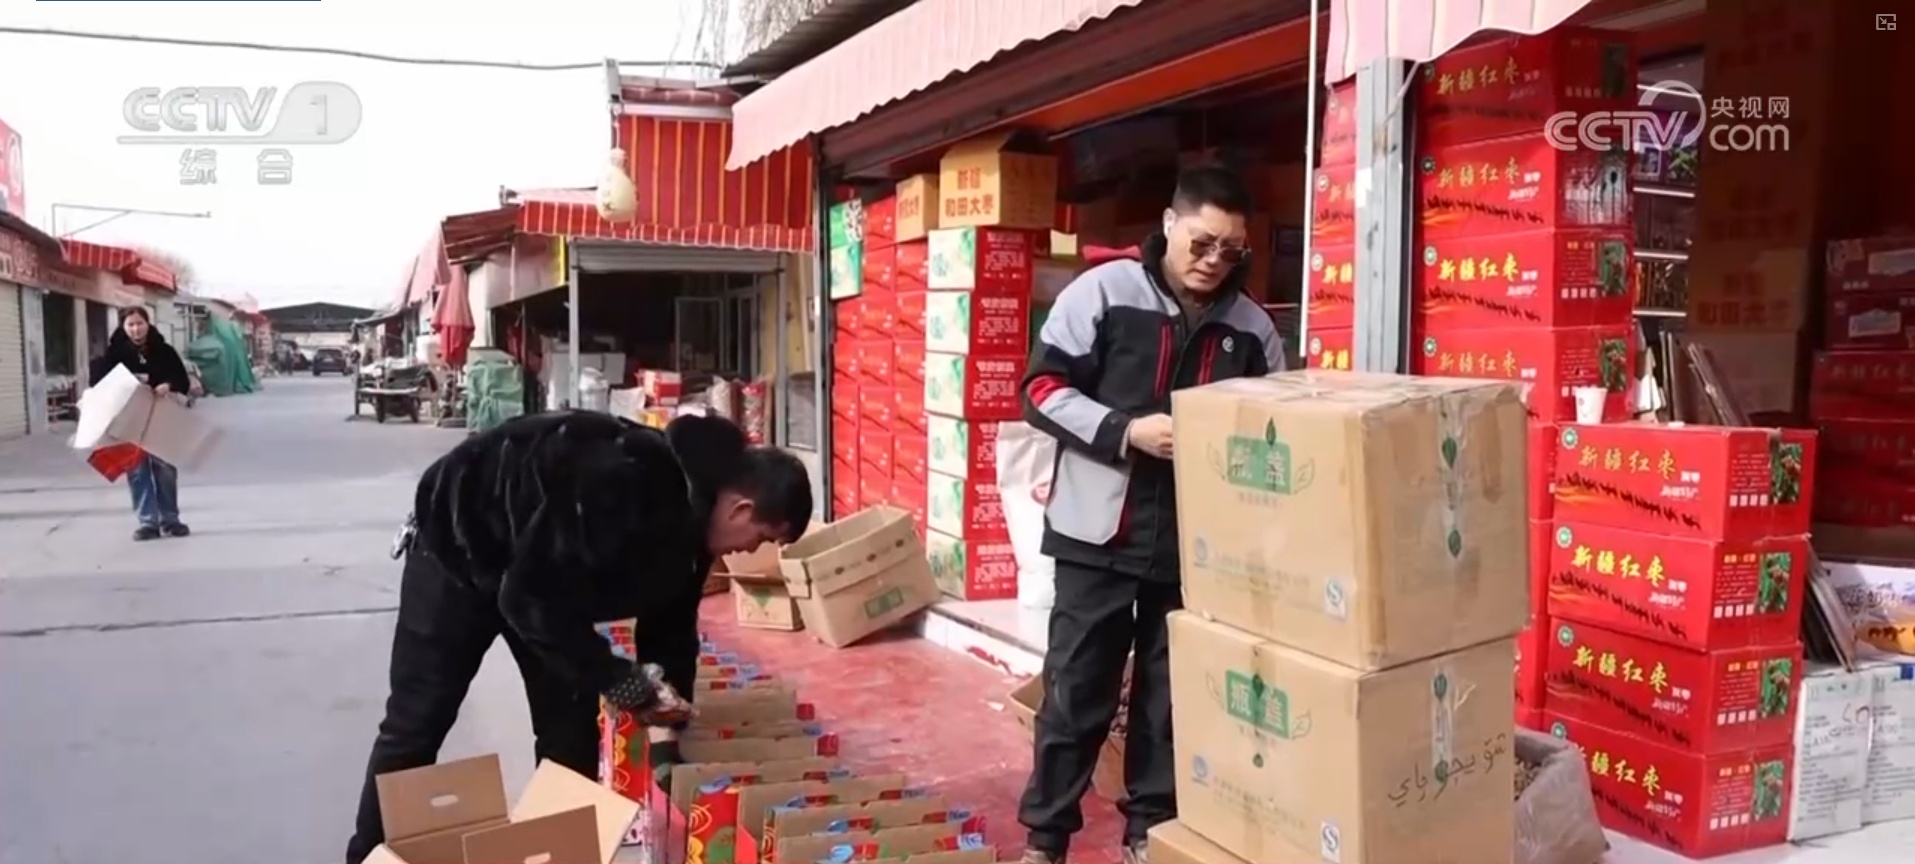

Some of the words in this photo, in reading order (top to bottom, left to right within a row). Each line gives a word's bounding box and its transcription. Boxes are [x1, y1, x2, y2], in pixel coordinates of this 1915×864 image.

[1437, 56, 1520, 95] 新疆红枣
[1436, 156, 1521, 189] 新疆红枣
[945, 194, 994, 218] 和田大枣
[1436, 252, 1520, 284] 新疆红枣
[1437, 351, 1518, 378] 新疆红枣
[1578, 445, 1677, 480] 新疆红枣
[1571, 545, 1666, 588] 新疆红枣
[1572, 645, 1669, 694] 新疆红枣
[1574, 745, 1662, 796] 疆红枣
